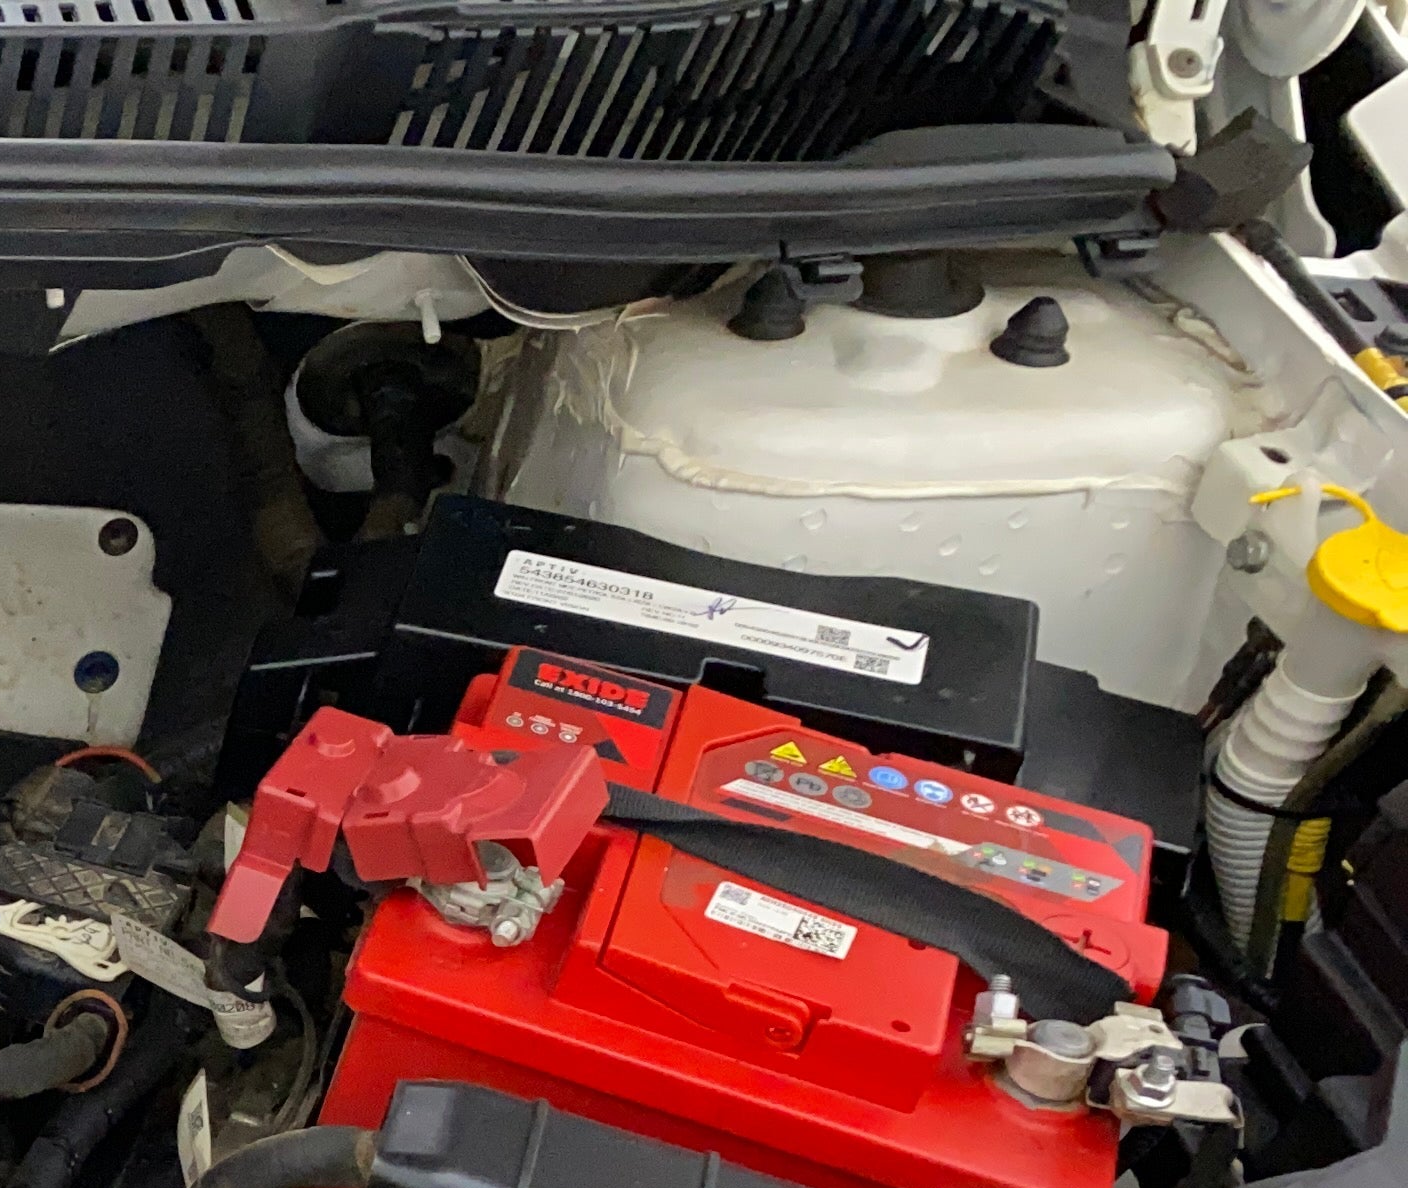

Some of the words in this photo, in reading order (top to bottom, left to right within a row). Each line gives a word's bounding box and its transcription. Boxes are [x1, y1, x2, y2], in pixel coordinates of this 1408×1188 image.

[522, 557, 580, 576] APTIV
[534, 679, 554, 690] Call
[554, 686, 565, 694] at
[537, 663, 650, 709] EXIDE
